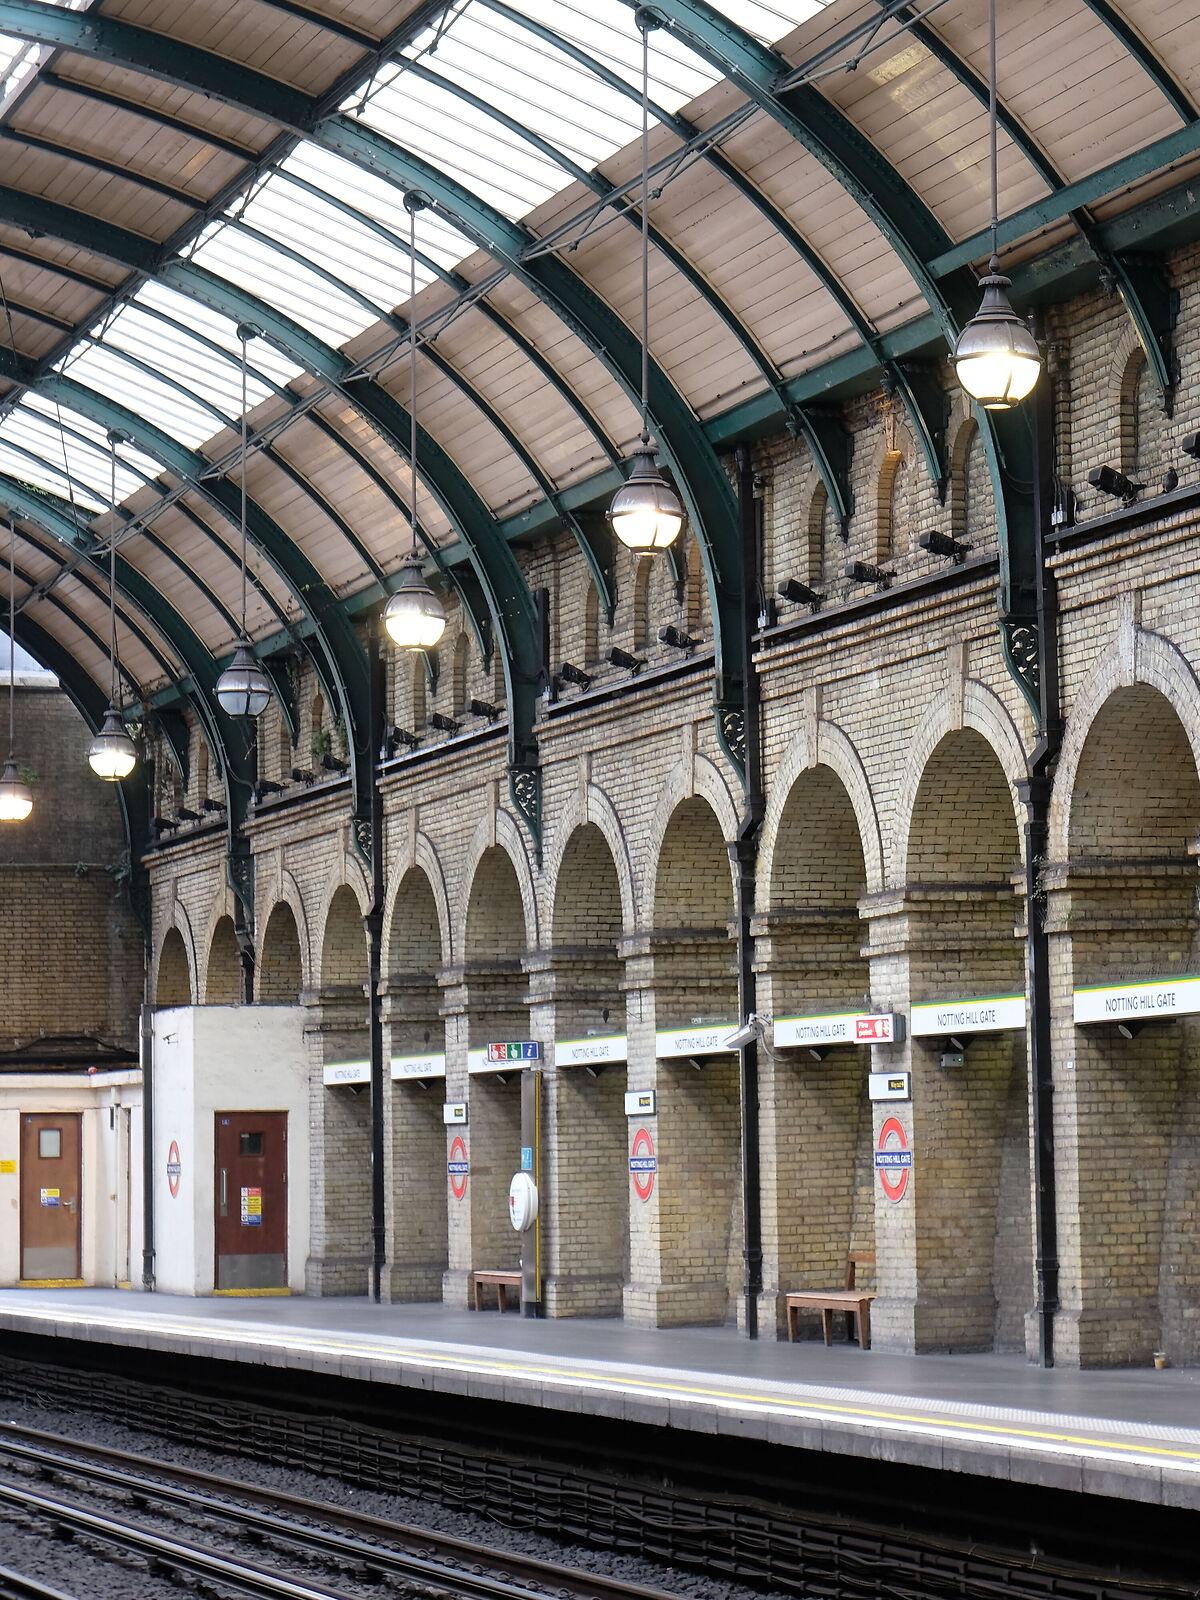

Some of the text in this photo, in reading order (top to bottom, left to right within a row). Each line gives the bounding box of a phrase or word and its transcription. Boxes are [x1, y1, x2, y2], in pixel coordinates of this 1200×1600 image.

[1105, 992, 1176, 1012] NOTTING HILL GATE
[937, 1009, 996, 1027] NOTTING HILL GATE
[795, 1023, 846, 1039] NOTTING HILL GATE
